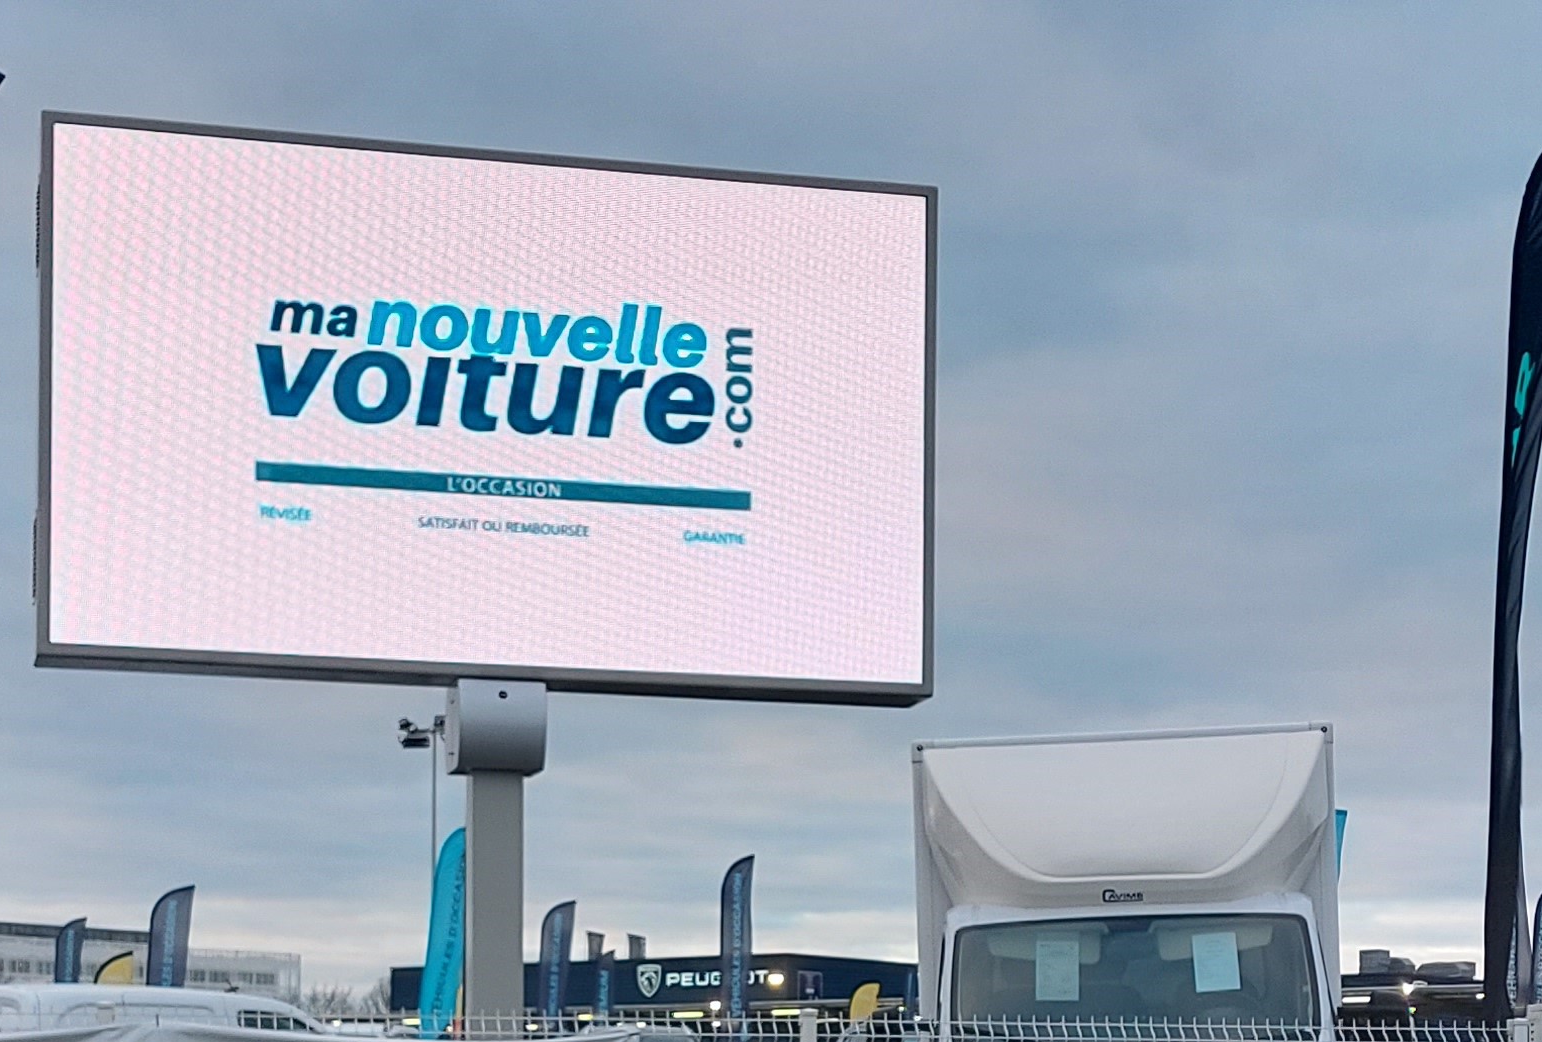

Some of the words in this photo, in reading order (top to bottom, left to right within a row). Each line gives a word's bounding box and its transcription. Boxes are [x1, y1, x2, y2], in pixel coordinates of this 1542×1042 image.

[270, 299, 357, 337] ma
[367, 299, 708, 368] nouvelle
[255, 343, 716, 445] voiture
[724, 327, 754, 448] .com
[446, 477, 562, 498] L'OCCASION
[417, 516, 479, 531] SATISFAIT
[482, 520, 502, 532] OU
[505, 521, 591, 538] REMBOURSÉE
[665, 969, 770, 988] PEUGT
